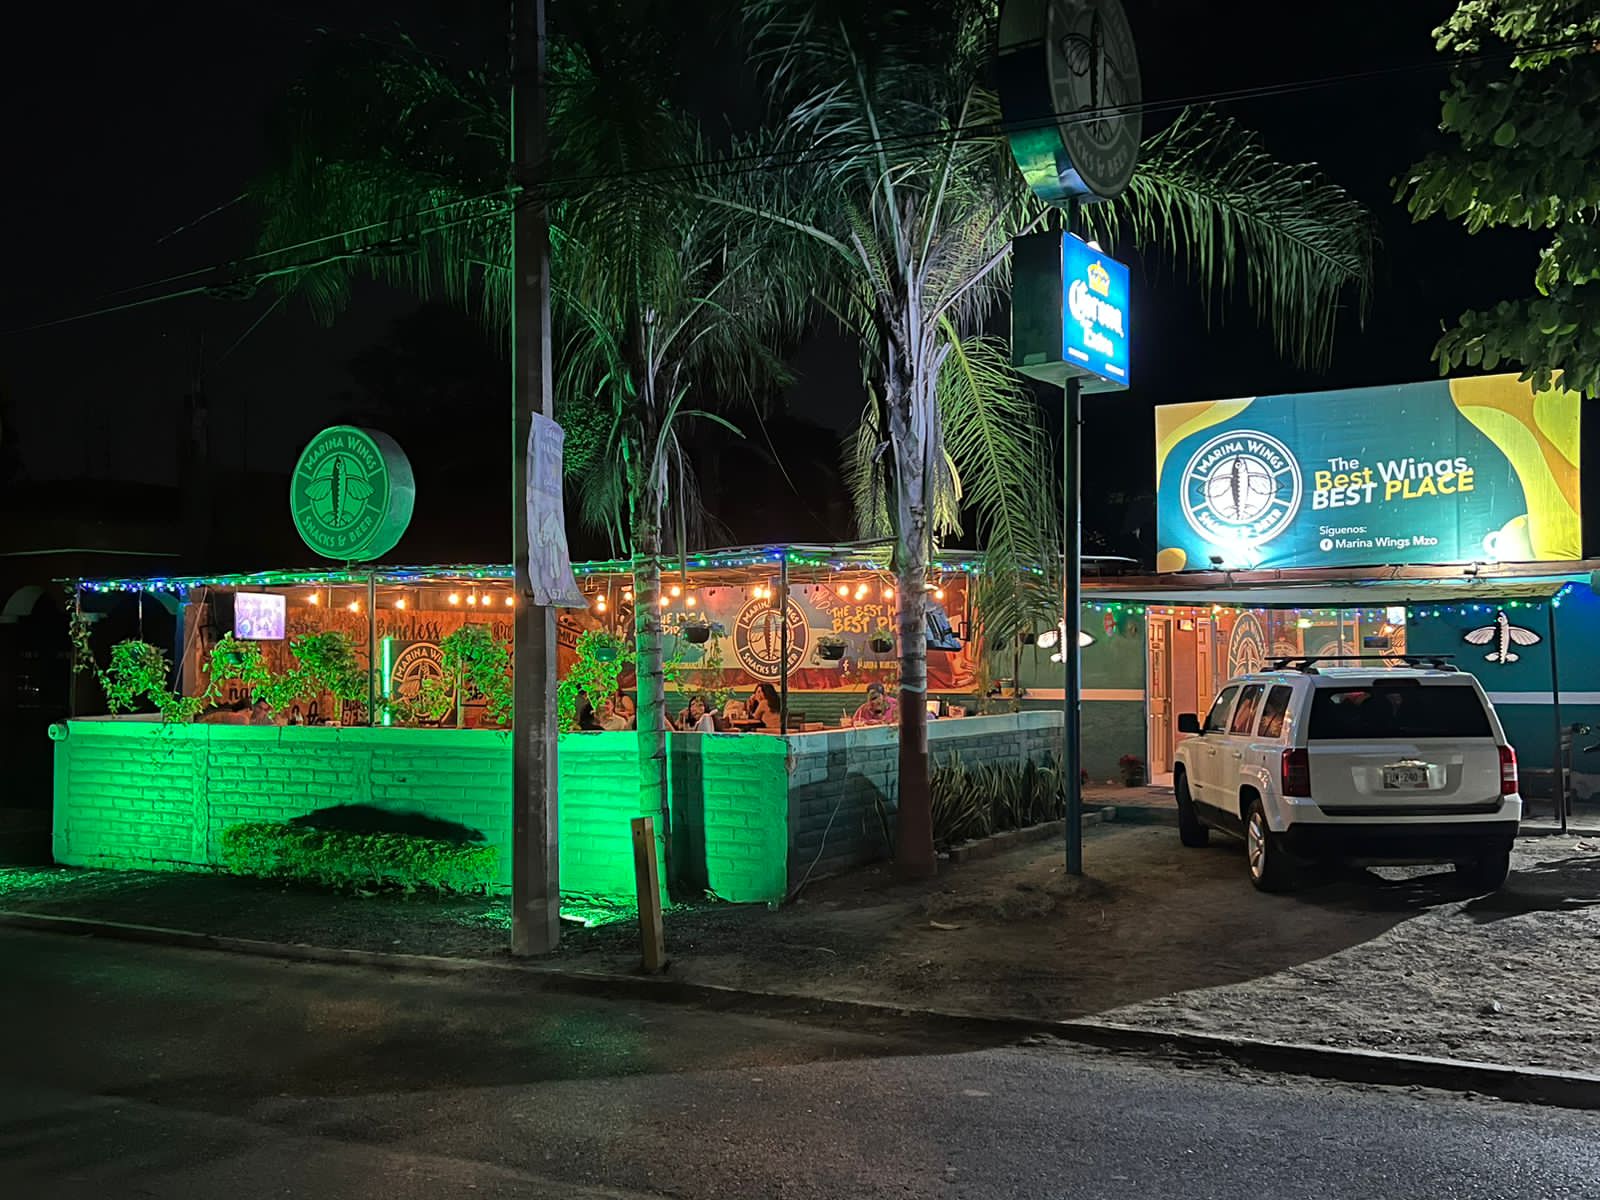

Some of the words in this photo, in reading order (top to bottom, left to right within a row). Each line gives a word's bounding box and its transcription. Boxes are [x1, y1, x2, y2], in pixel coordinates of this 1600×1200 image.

[304, 437, 344, 471] MARINA
[347, 435, 378, 470] WINGS
[1196, 440, 1244, 474] MARINA
[1247, 440, 1285, 471] WINGS
[1328, 457, 1360, 473] The
[1312, 481, 1378, 510] BEST
[1384, 469, 1475, 501] PLACE
[1315, 467, 1374, 492] Best
[302, 515, 335, 547] SNACKS
[348, 516, 374, 542] BEER
[1335, 537, 1373, 549] Marina
[1374, 536, 1411, 549] Wings
[1412, 535, 1439, 546] Mzo
[831, 605, 851, 618] THE
[855, 603, 883, 617] BEST
[831, 615, 871, 634] BEST
[398, 648, 429, 679] MARINA
[742, 652, 770, 675] SNACKS
[770, 665, 779, 674] &
